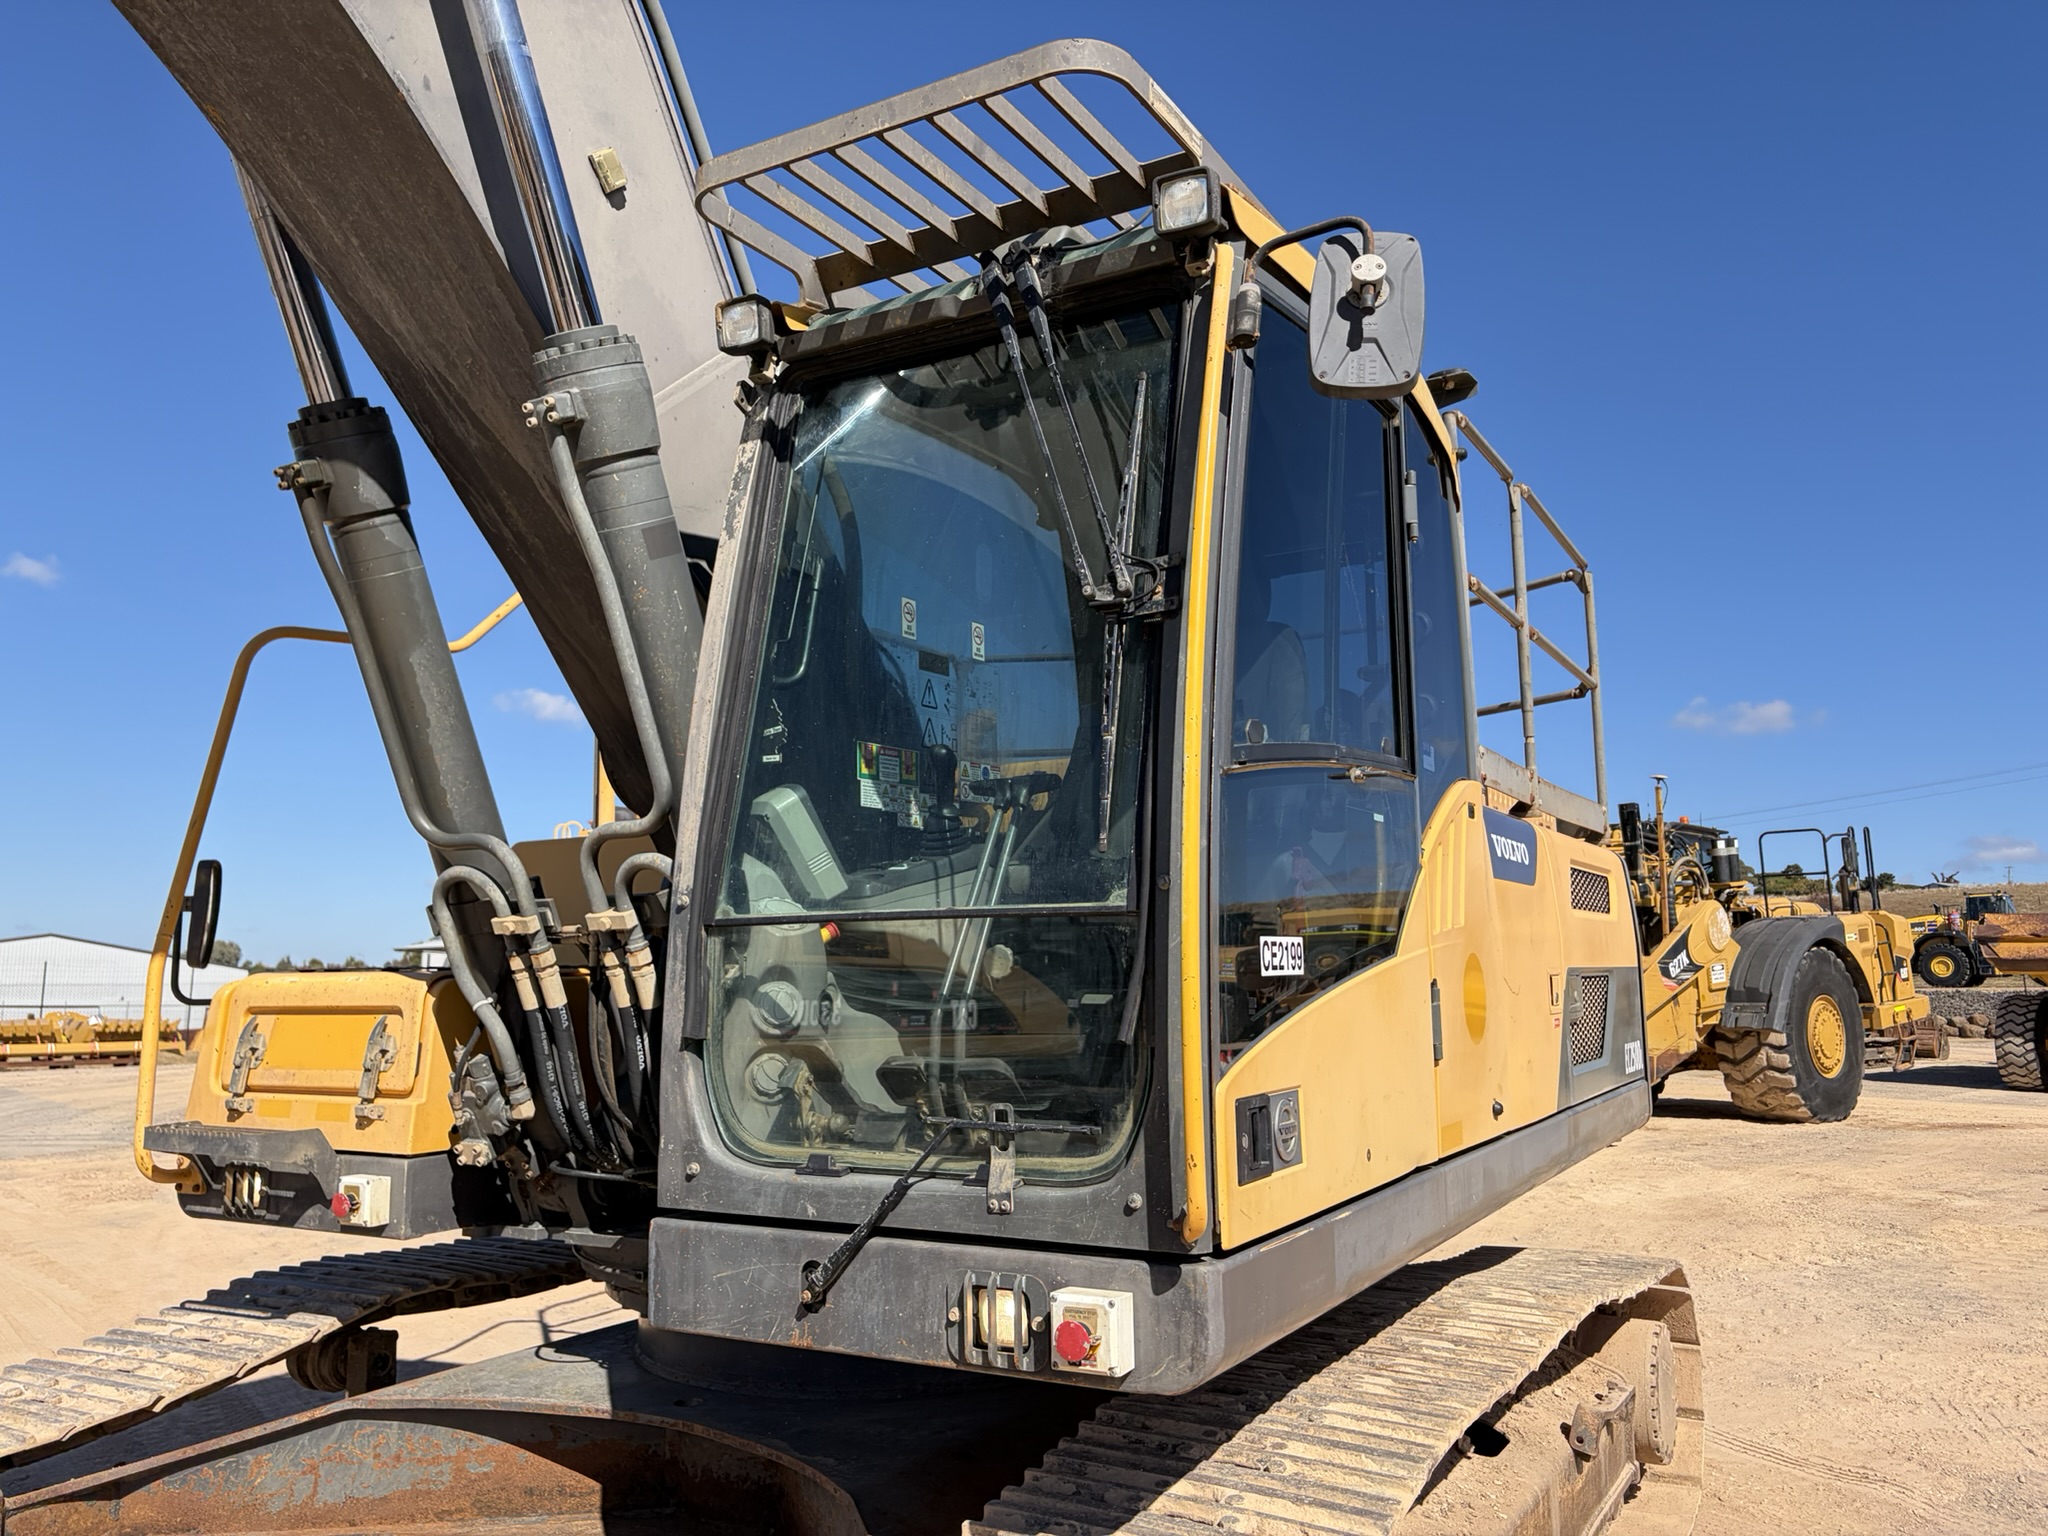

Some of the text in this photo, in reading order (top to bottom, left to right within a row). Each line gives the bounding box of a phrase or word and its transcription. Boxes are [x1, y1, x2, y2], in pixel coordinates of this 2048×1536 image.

[1490, 833, 1530, 866] VOLVO
[1262, 940, 1303, 972] CE2199
[1668, 949, 1690, 978] 627K
